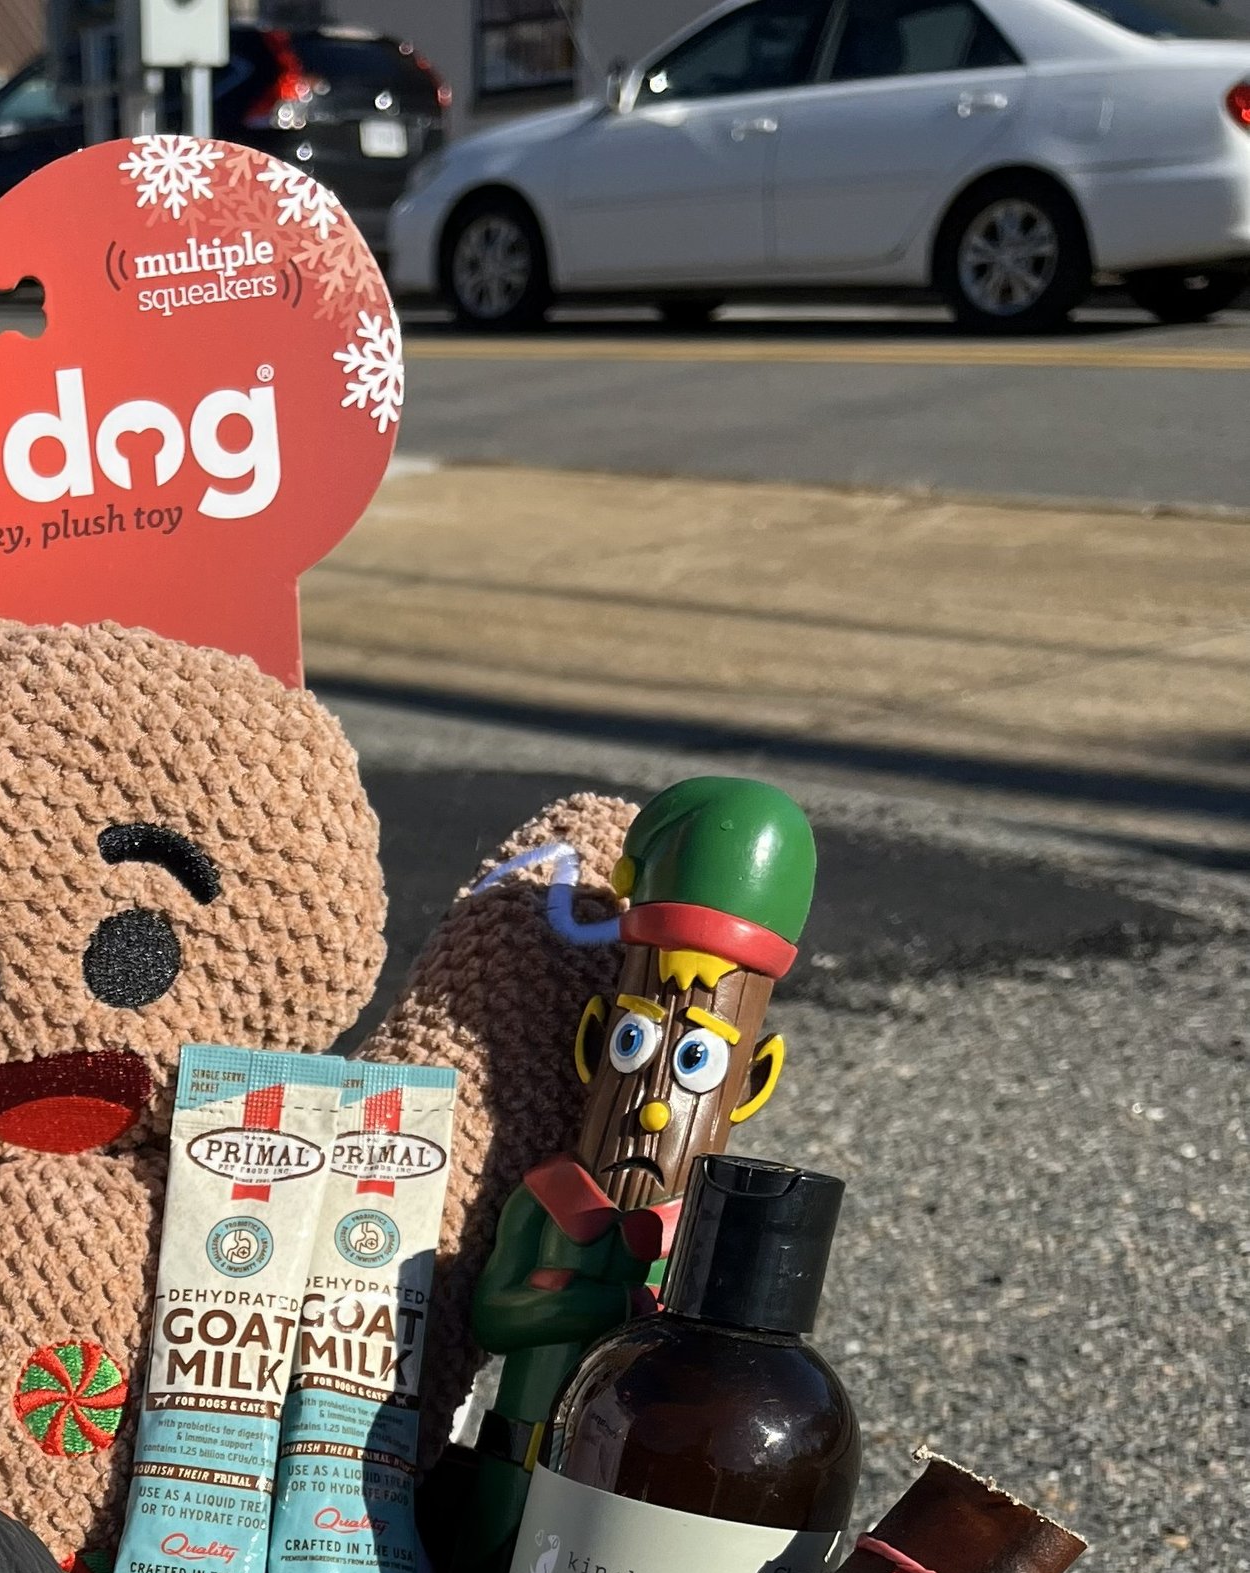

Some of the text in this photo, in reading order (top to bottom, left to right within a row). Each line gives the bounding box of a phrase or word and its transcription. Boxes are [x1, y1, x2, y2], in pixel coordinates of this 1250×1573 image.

[134, 231, 274, 279] multiple
[138, 271, 277, 317] squeakers
[41, 503, 126, 551] plush
[134, 504, 183, 536] toy
[204, 1139, 309, 1167] PRIMAL
[331, 1144, 431, 1168] PRIMAL
[169, 1289, 299, 1312] DEHYDRATED
[162, 1308, 296, 1354] GOAT
[300, 1293, 424, 1346] GOAT
[301, 1331, 413, 1386] MILK
[166, 1349, 283, 1395] MILK
[313, 1376, 387, 1402] FOR DOGS CATS
[175, 1396, 266, 1414] FOR DOGS & CATS
[158, 1418, 175, 1427] with
[177, 1420, 220, 1434] probiotics
[223, 1426, 235, 1436] for
[143, 1442, 225, 1460] contains 1.25 billion
[220, 1440, 253, 1450] support
[325, 1444, 354, 1457] THEIR
[178, 1468, 210, 1481] THEIR
[213, 1472, 251, 1487] PRIMAL
[288, 1464, 380, 1483] USE AS A LIQUID
[138, 1486, 268, 1513] USE AS A LIQUID TREA
[291, 1480, 382, 1499] OR TO HYDRATE
[141, 1502, 157, 1515] OR
[161, 1504, 175, 1517] TO
[179, 1507, 233, 1526] HYDRATE
[314, 1507, 390, 1537] Quality
[160, 1532, 239, 1564] Quality
[285, 1539, 414, 1561] CRAFTED IN THE USA
